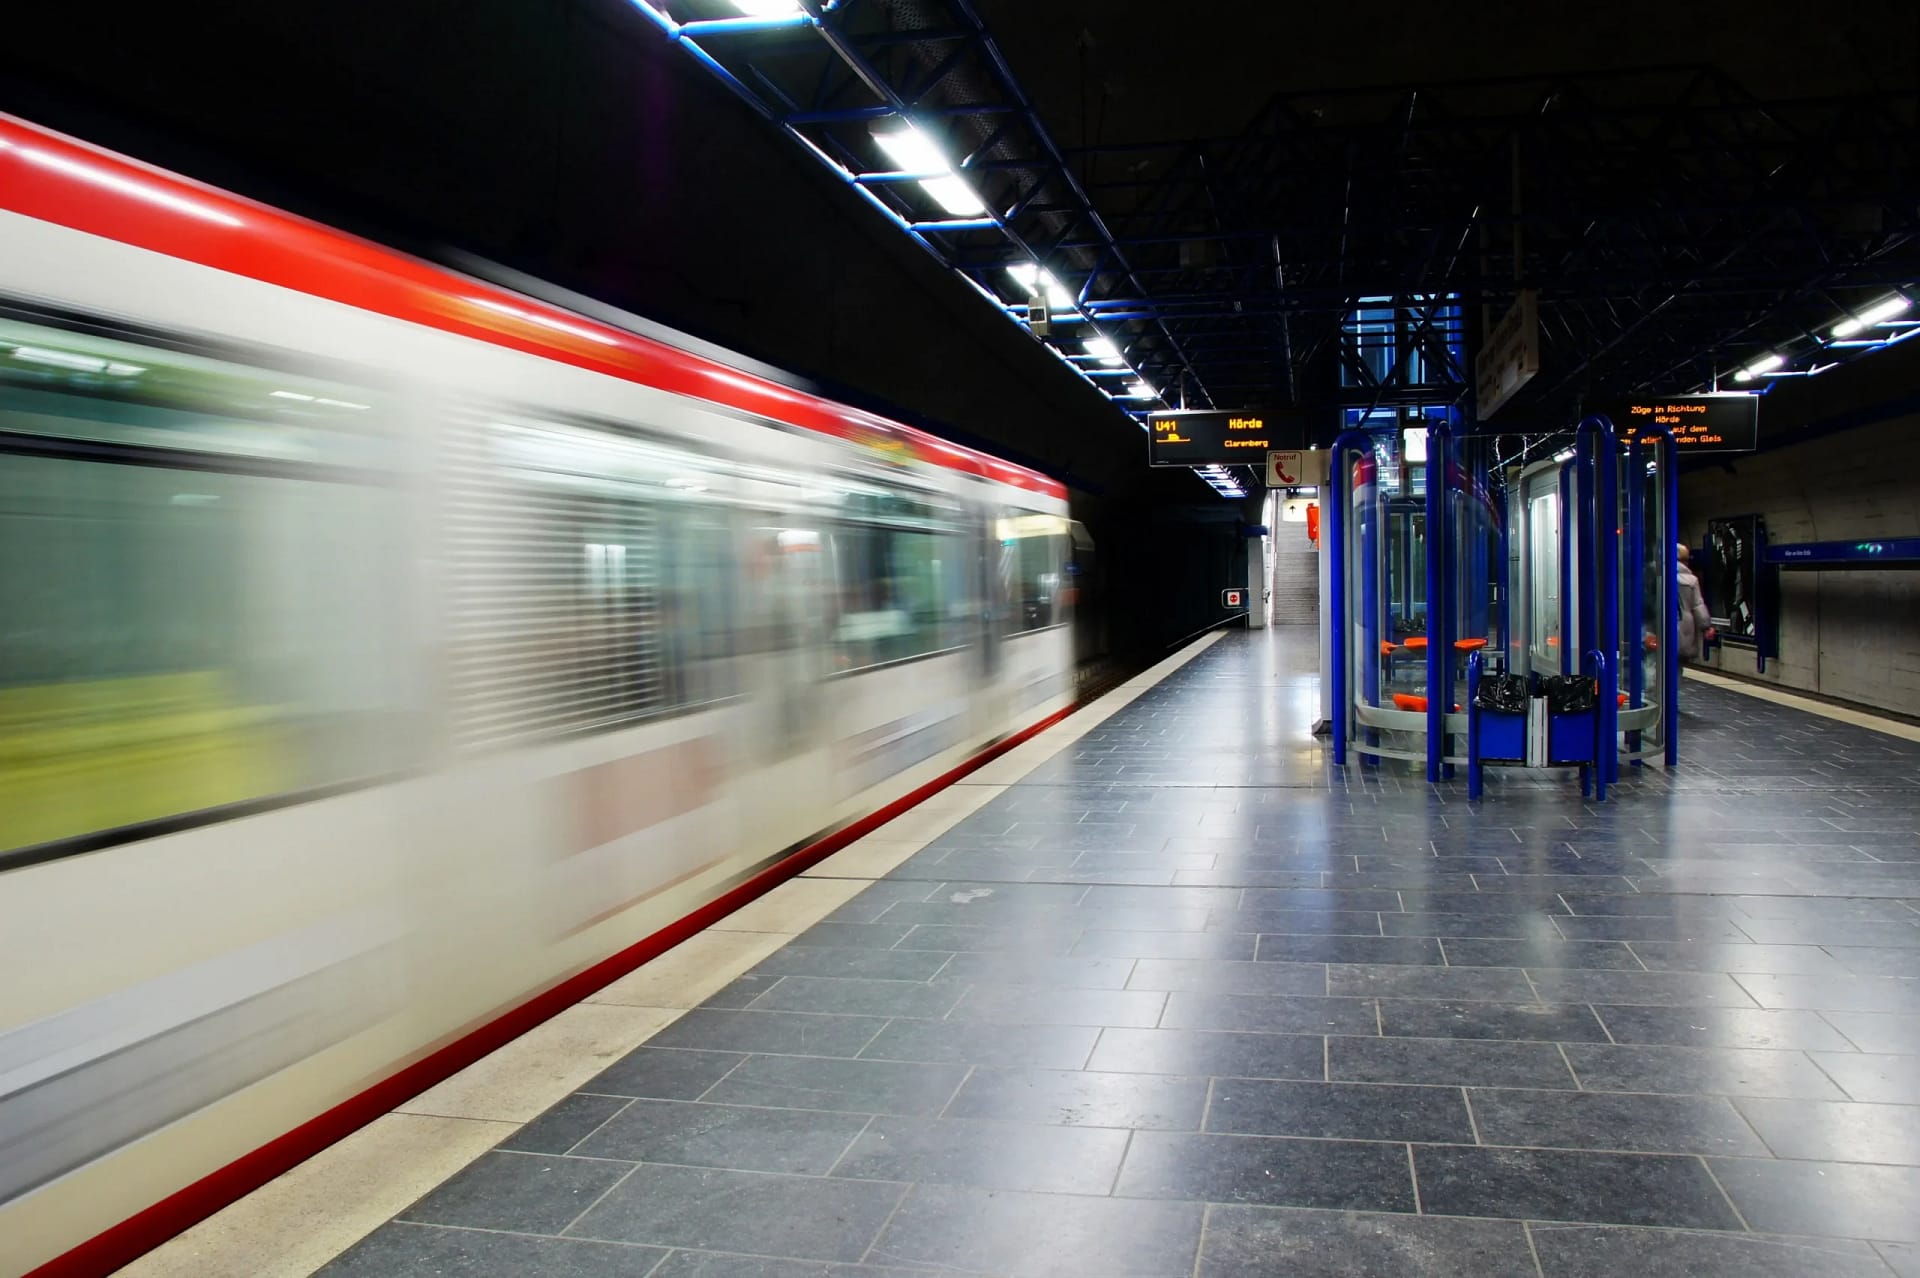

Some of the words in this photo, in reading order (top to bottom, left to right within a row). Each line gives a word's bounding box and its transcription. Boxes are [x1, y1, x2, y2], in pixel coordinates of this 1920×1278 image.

[1631, 406, 1652, 415] Züge
[1667, 405, 1706, 414] Richtung
[1156, 420, 1177, 431] U41
[1229, 418, 1263, 429] Hörde
[1672, 425, 1686, 434] auf
[1690, 425, 1707, 433] dem
[1224, 439, 1269, 448] Clarenberg
[1700, 435, 1722, 443] Gleis
[1273, 453, 1297, 461] Notruf
